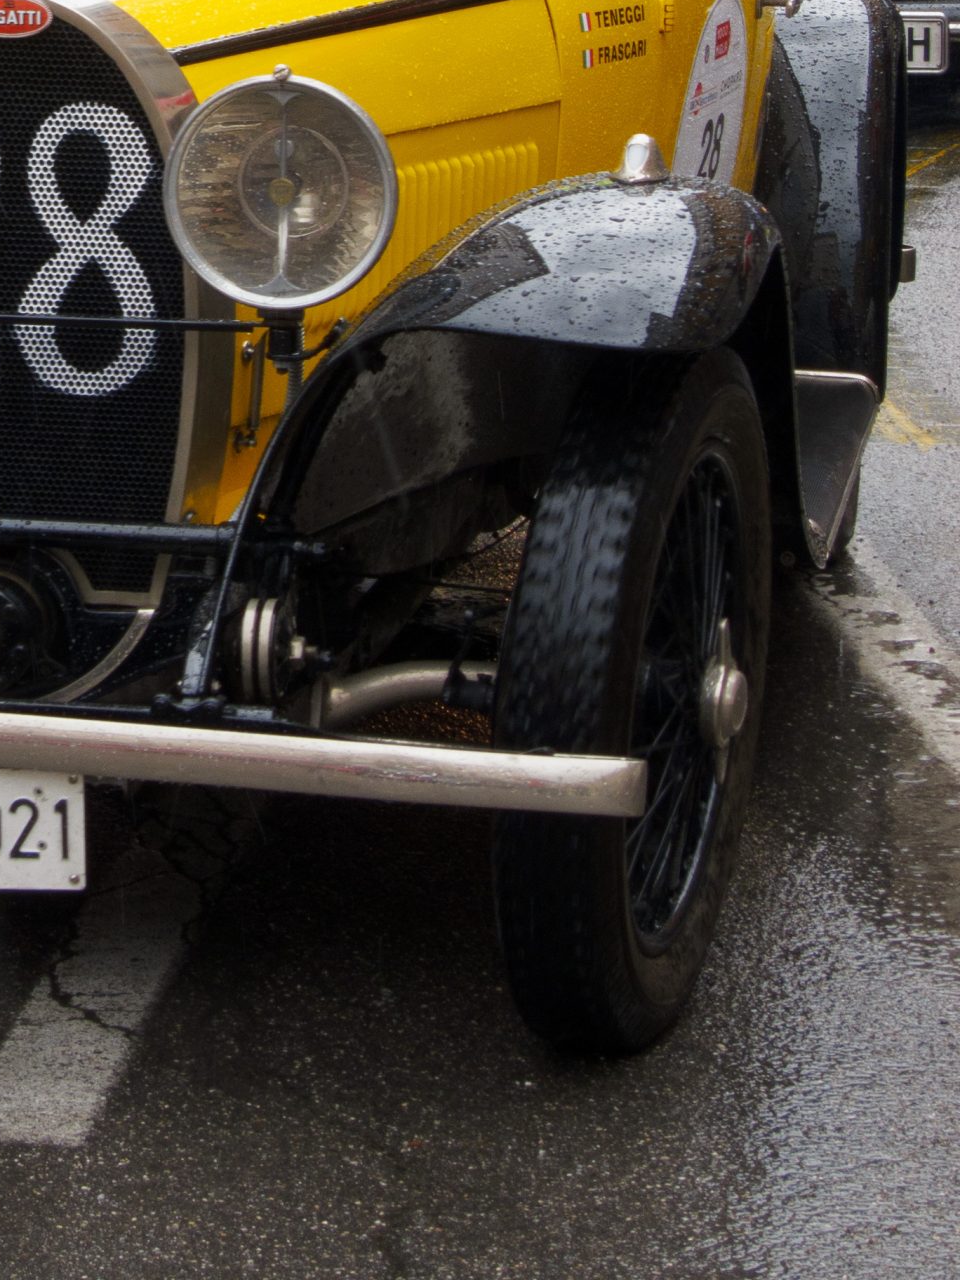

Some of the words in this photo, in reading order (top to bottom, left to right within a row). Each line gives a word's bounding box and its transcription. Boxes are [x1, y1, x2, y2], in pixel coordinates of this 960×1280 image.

[595, 4, 645, 28] TENEGGI
[598, 39, 647, 64] FRASCARI
[697, 112, 725, 180] 28
